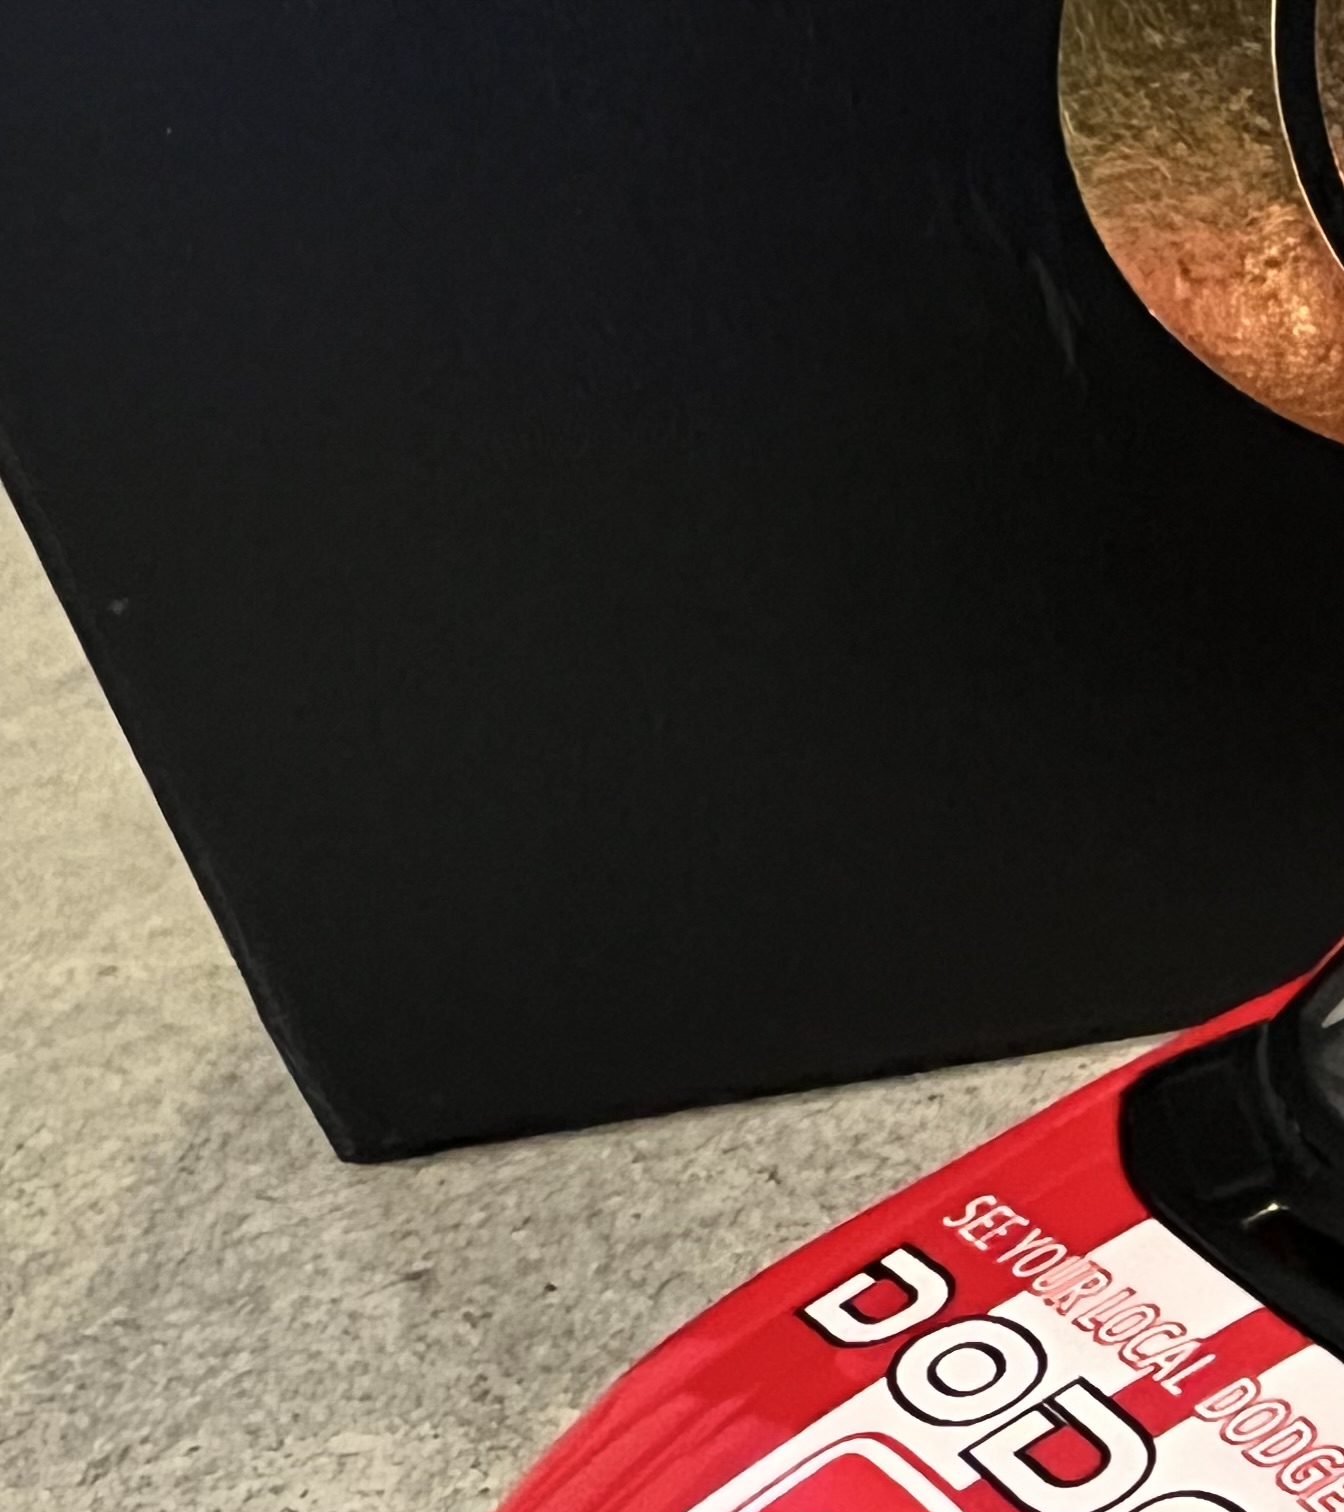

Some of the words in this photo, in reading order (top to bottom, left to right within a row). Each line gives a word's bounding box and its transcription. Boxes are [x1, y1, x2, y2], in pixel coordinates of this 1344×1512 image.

[942, 1194, 1030, 1252] SEE
[995, 1227, 1113, 1316] YOUR
[1071, 1286, 1216, 1396] LOCAL
